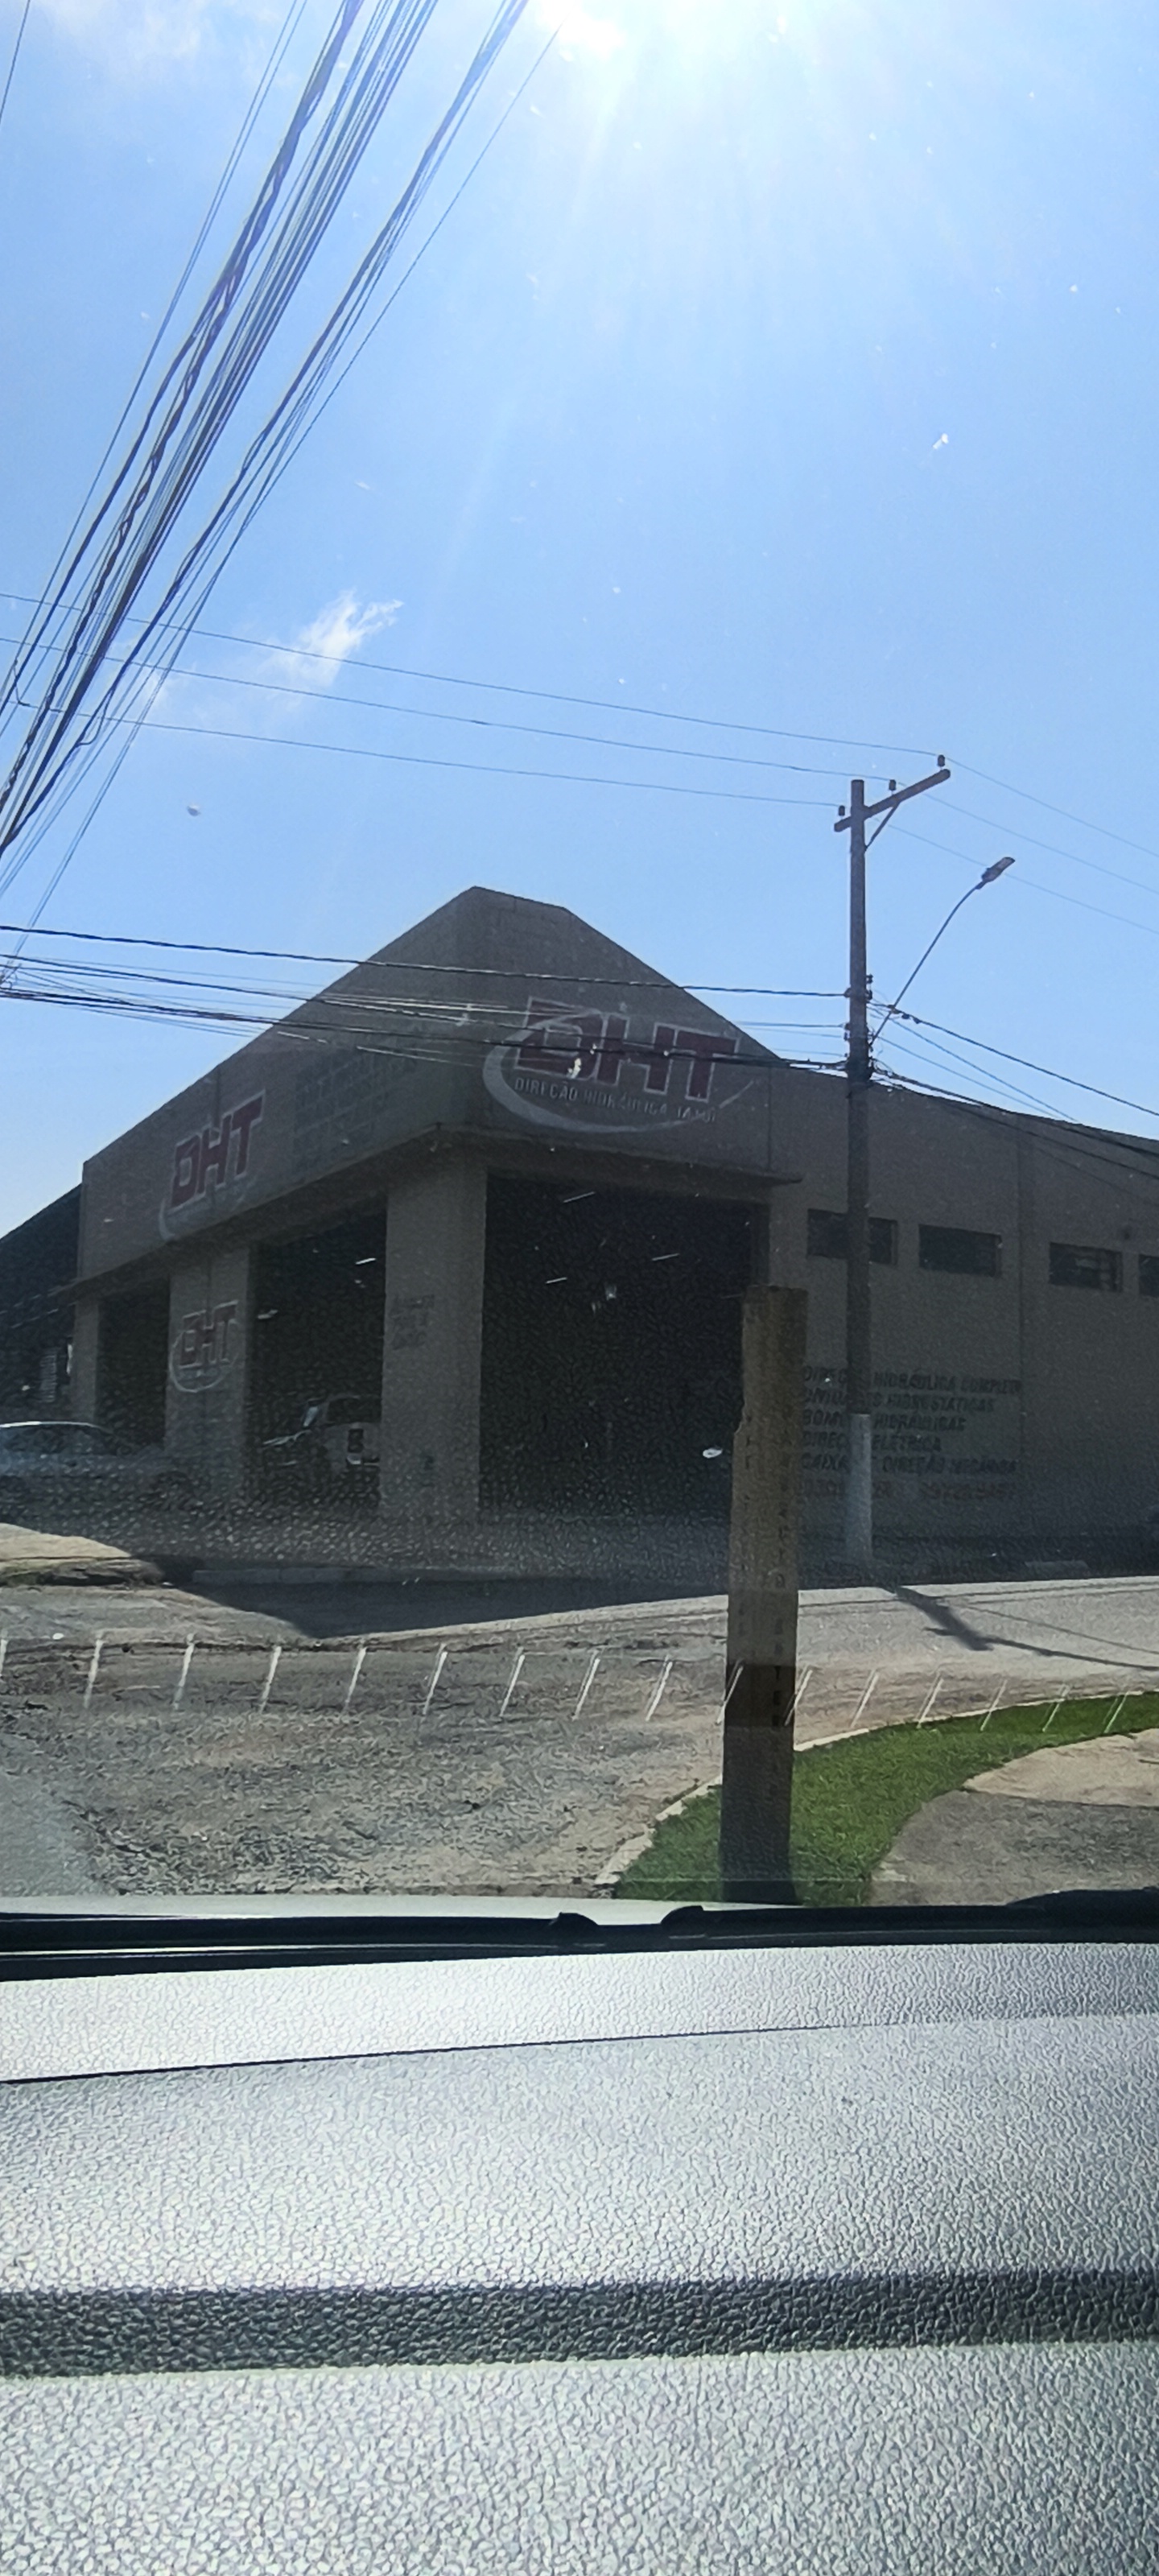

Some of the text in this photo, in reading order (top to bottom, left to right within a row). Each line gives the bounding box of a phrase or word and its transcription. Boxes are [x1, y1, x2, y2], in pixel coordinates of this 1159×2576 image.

[514, 996, 740, 1102] DHT
[514, 1077, 578, 1102] DIREÇÃO
[167, 1088, 267, 1215] DHT
[177, 1298, 241, 1370] DHT
[802, 1365, 848, 1385] DIREÇ
[802, 1431, 849, 1452] DIREÇ
